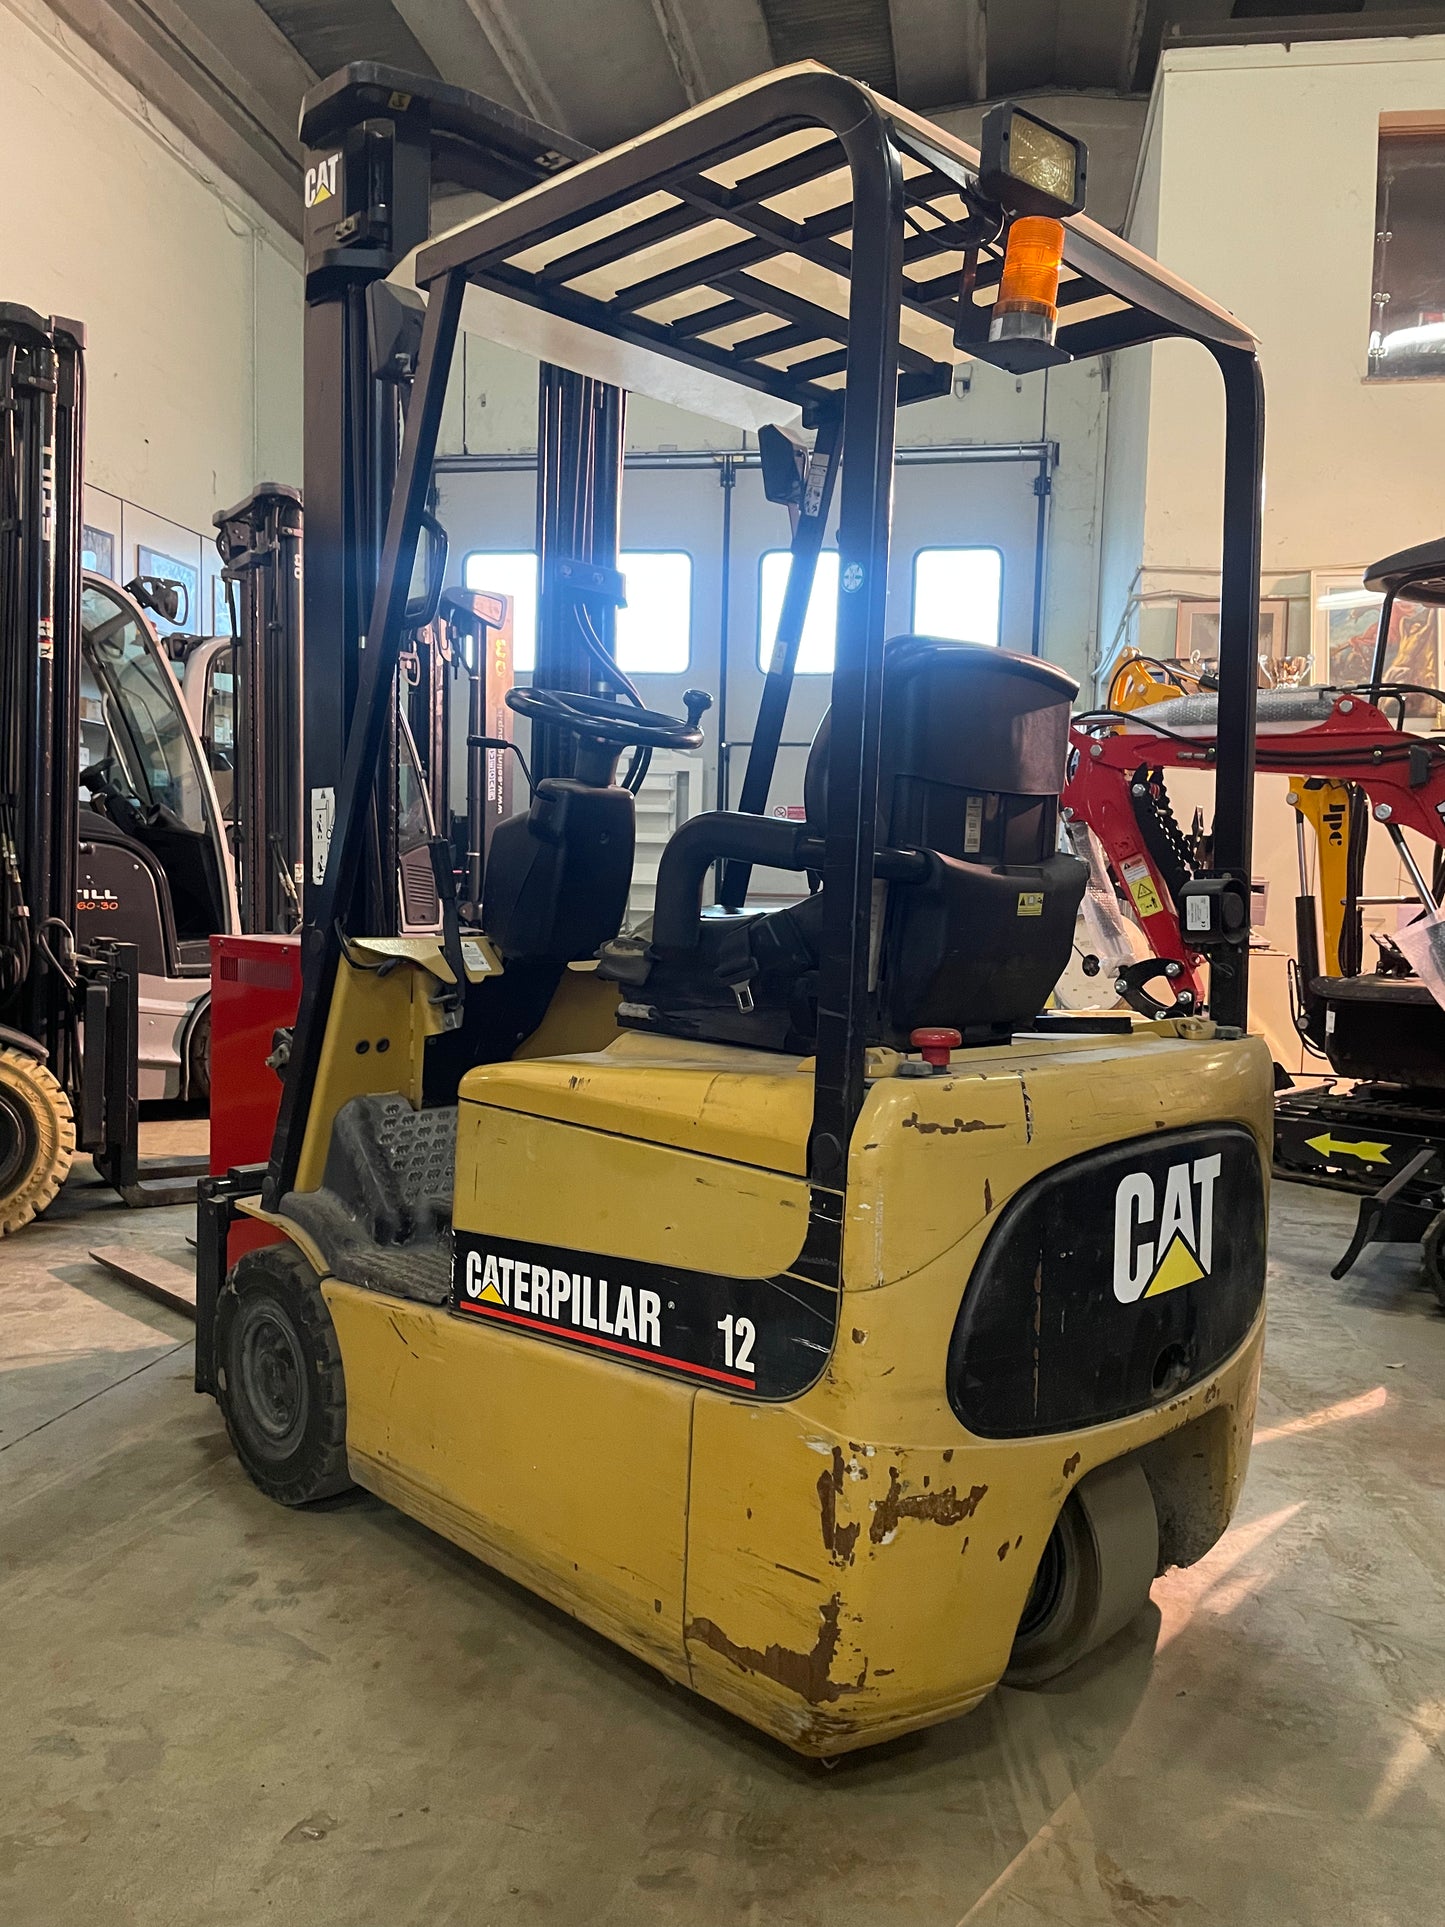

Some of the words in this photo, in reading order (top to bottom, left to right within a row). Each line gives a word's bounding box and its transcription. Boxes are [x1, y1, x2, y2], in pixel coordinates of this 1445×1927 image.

[305, 153, 339, 208] CAT
[496, 708, 505, 815] www.solinigoup.it
[1113, 1153, 1222, 1304] CAT
[466, 1251, 661, 1347] CATERPILLAR
[718, 1314, 756, 1373] 12
